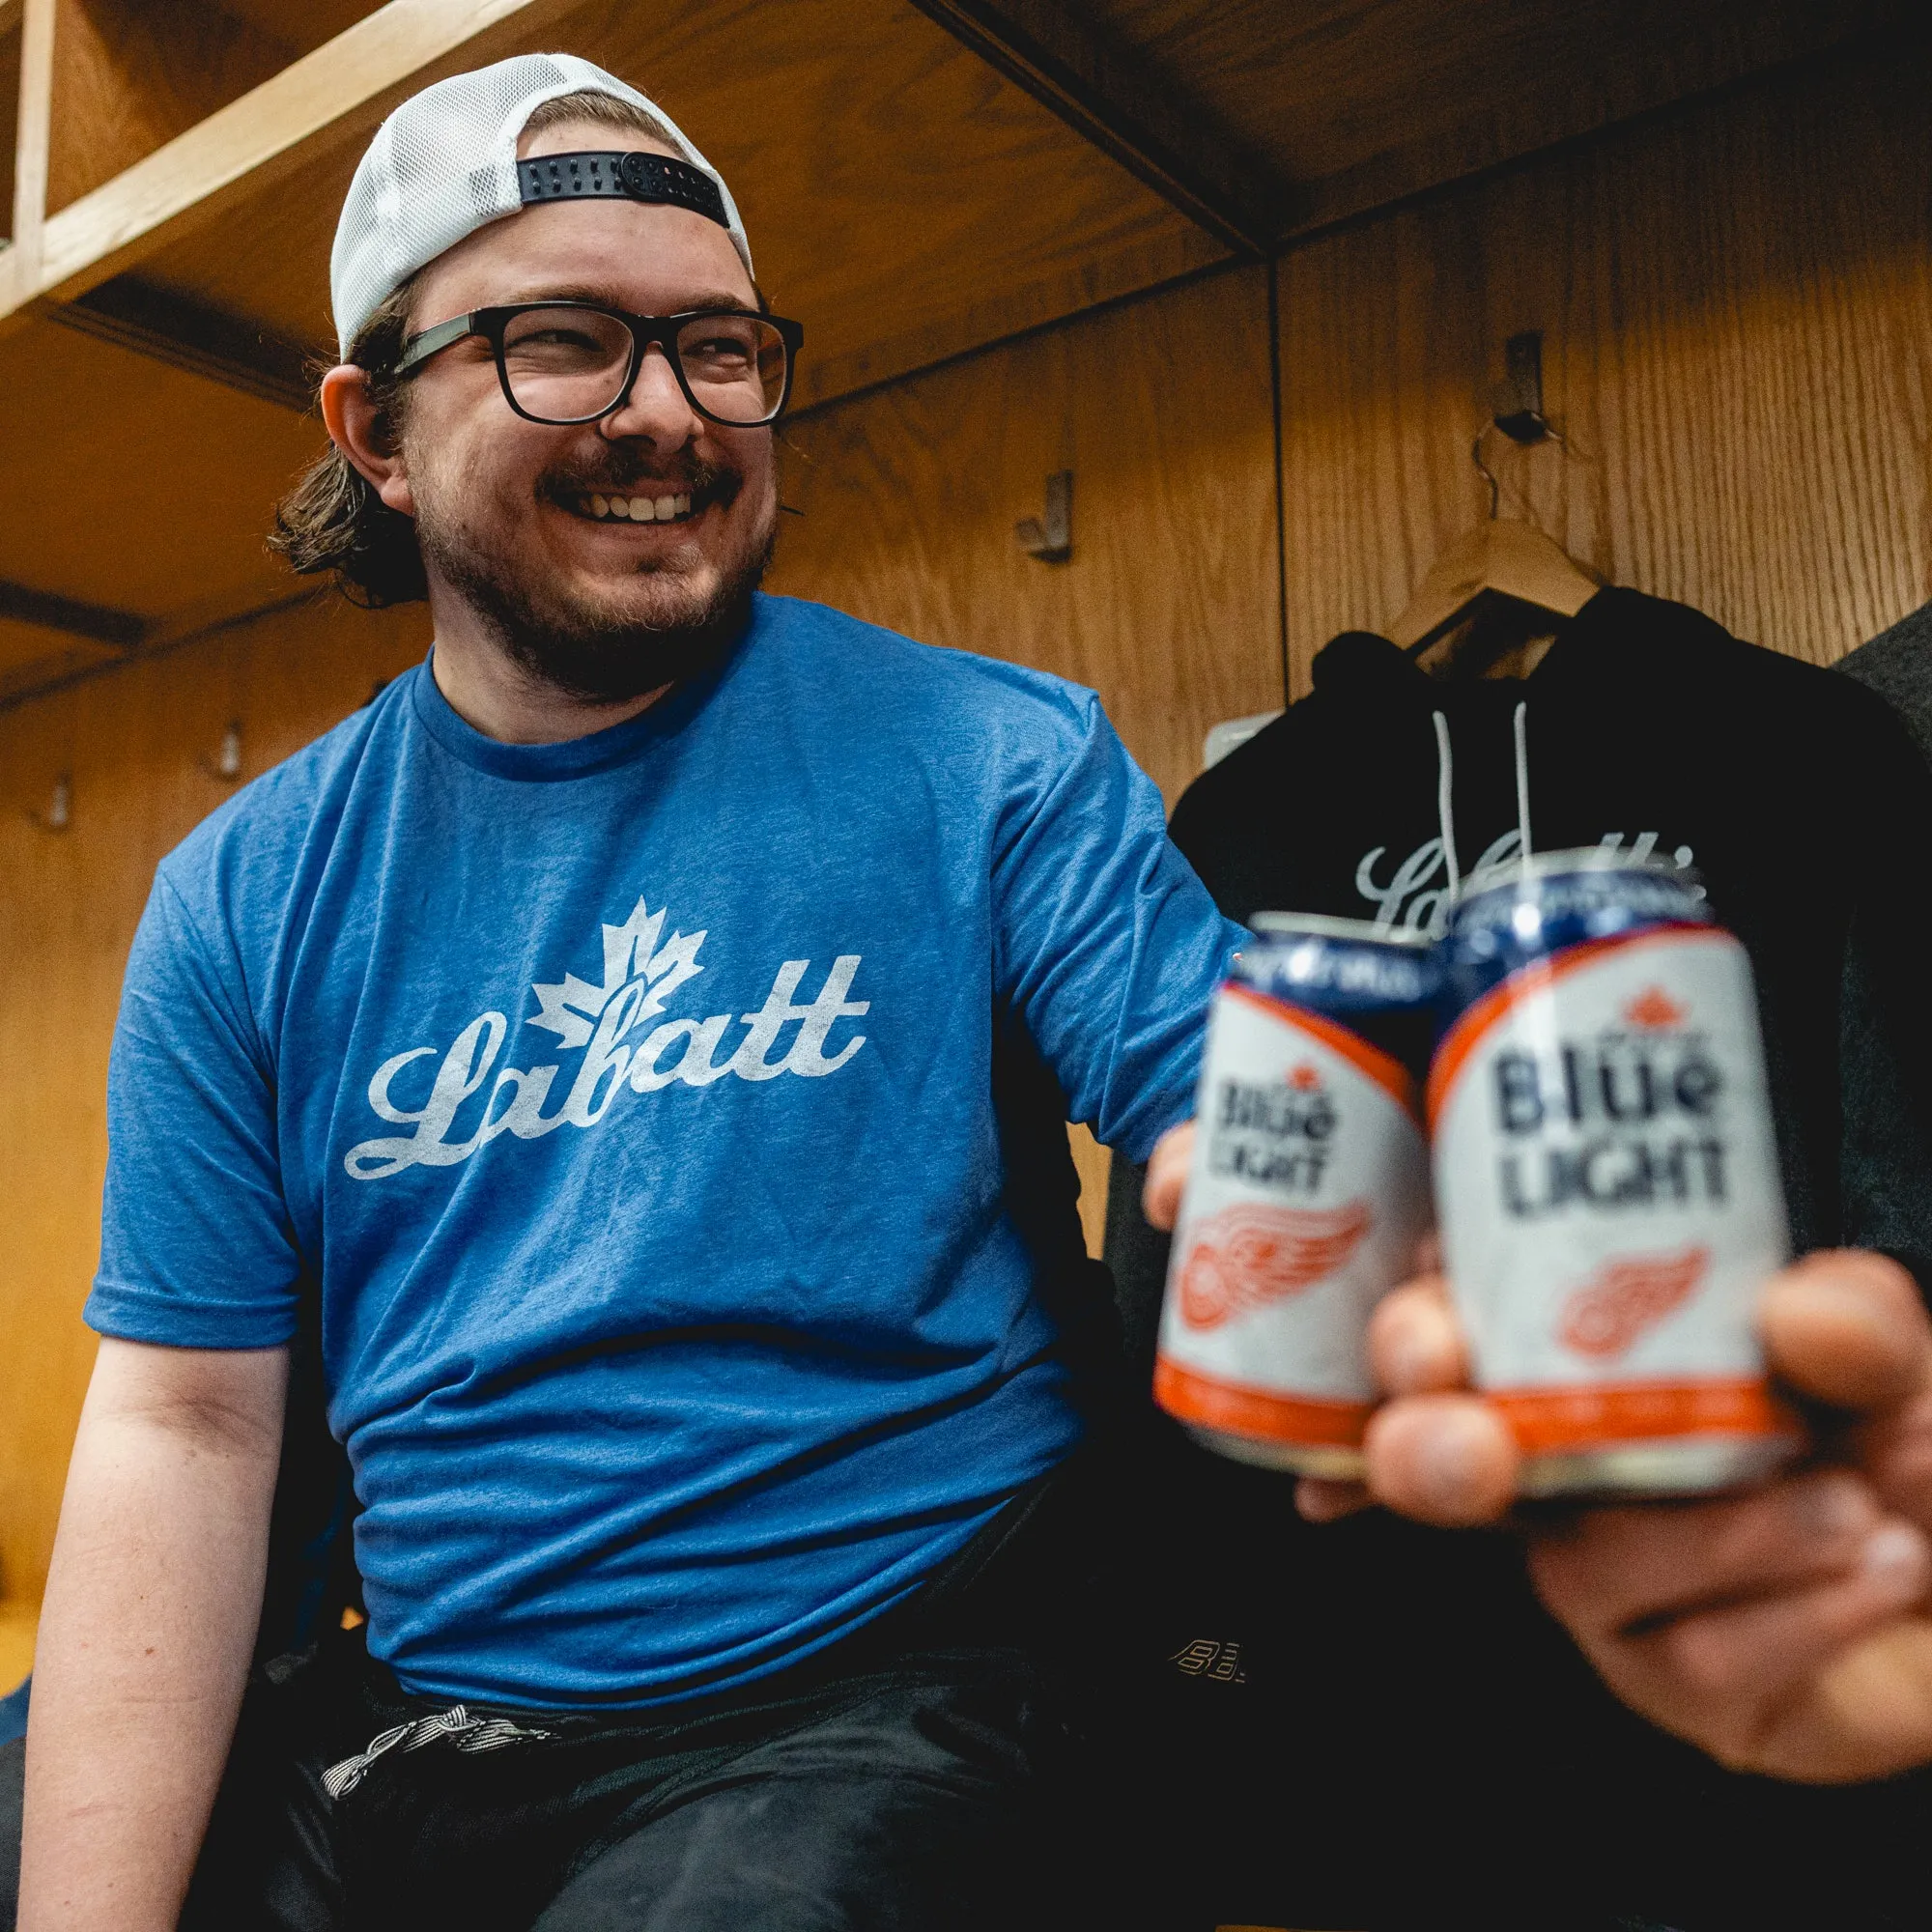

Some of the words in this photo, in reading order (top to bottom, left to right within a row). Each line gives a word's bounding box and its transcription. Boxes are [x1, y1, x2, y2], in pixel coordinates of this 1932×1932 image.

[343, 953, 871, 1180] Labatt
[1492, 1039, 1722, 1132] Blue
[1497, 1137, 1727, 1216] LIGHT
